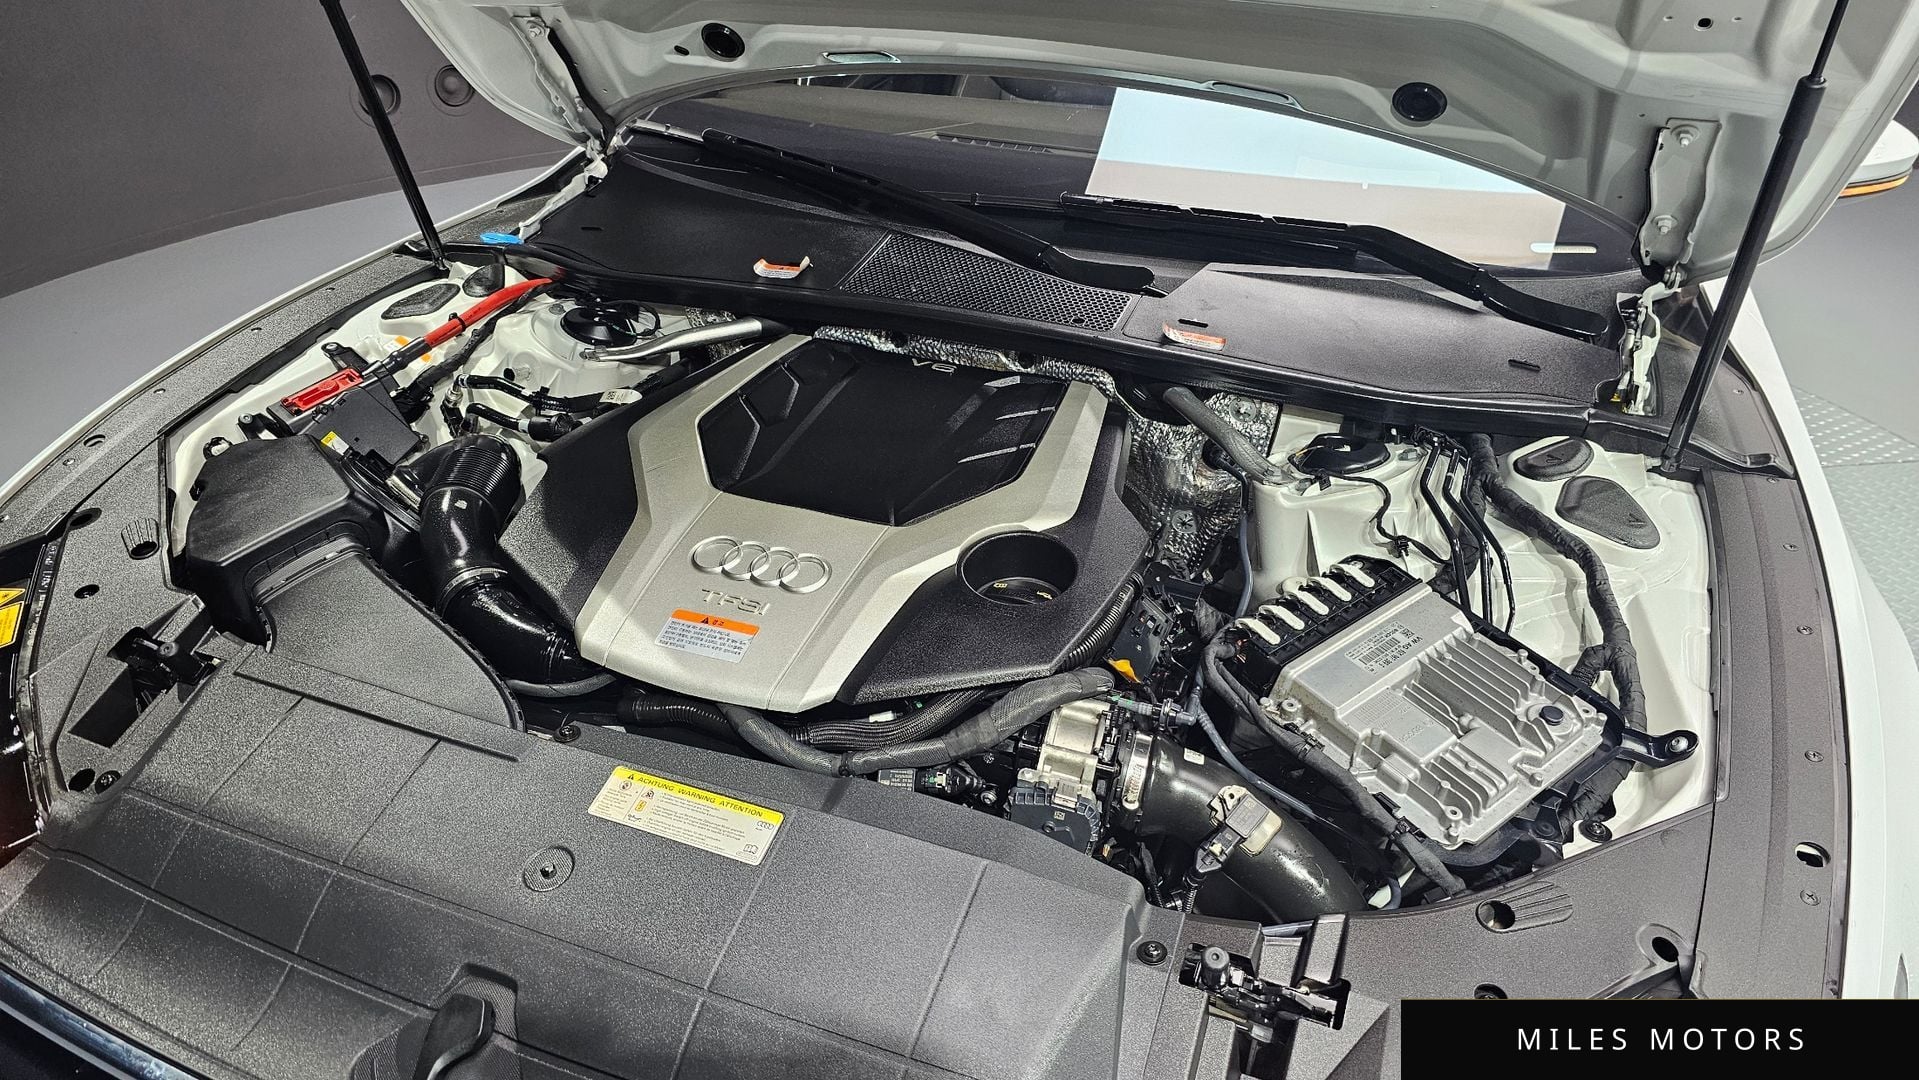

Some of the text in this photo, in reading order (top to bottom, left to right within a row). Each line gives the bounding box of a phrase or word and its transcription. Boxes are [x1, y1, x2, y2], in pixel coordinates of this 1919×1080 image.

[911, 358, 957, 373] V6
[701, 588, 771, 616] TFSI
[638, 777, 763, 818] ACHTUNG WARNING ATTENTION
